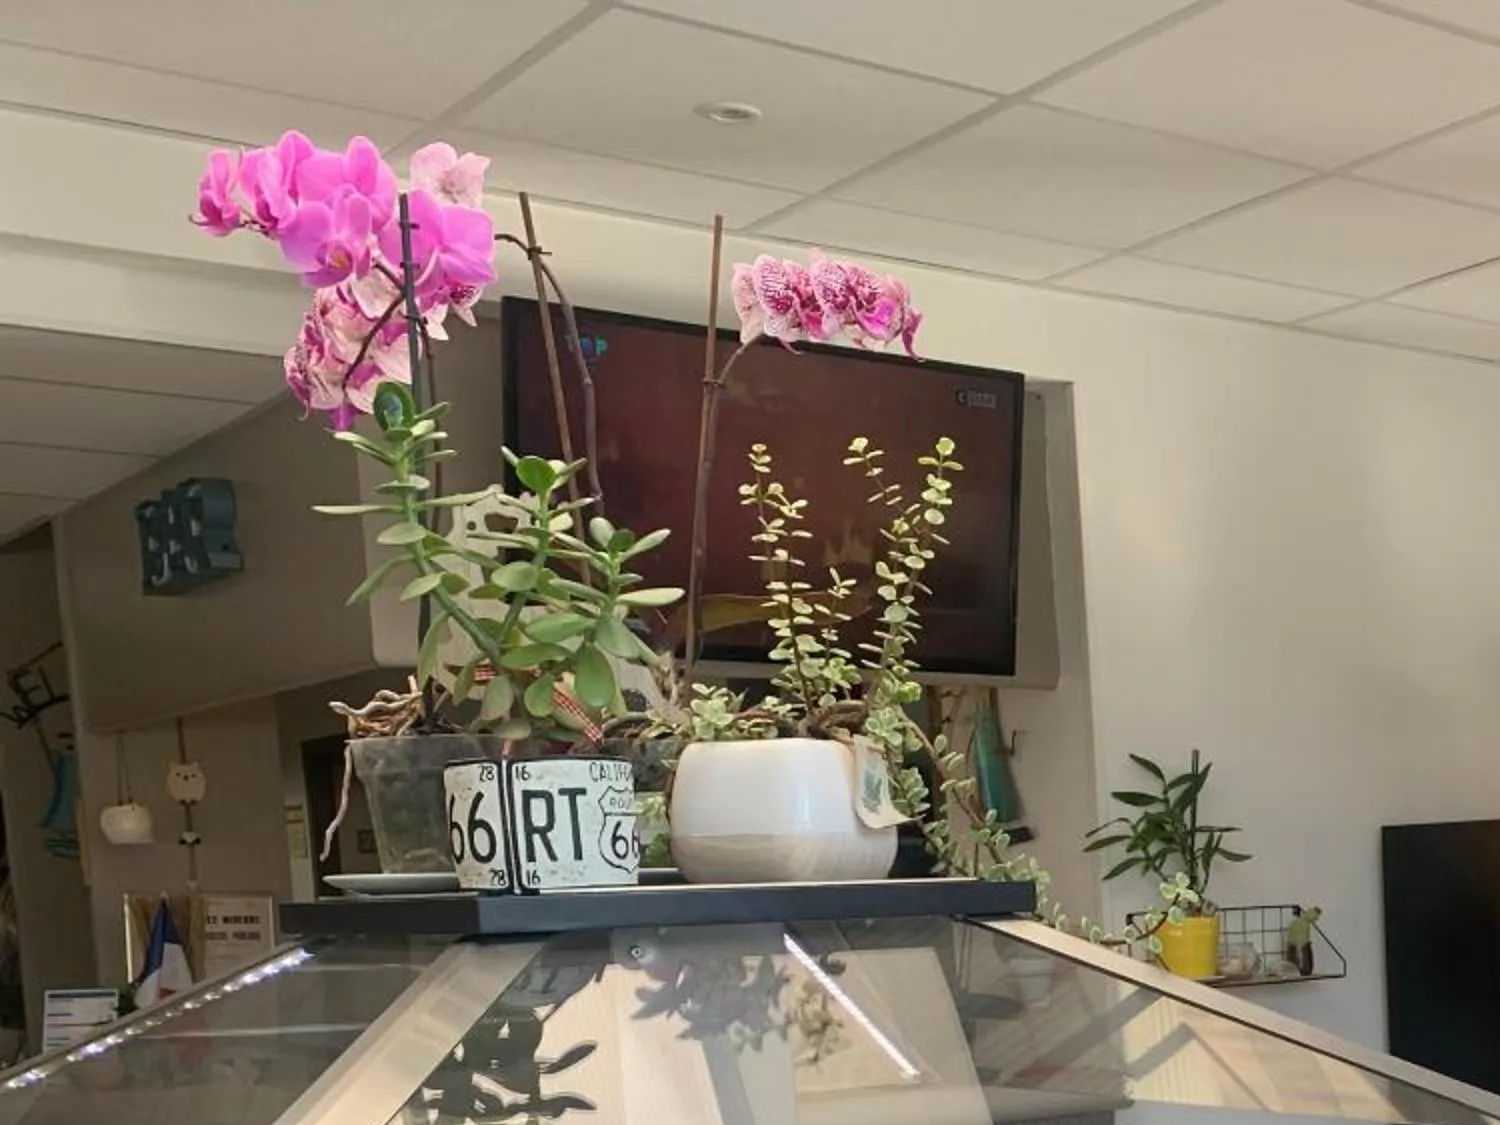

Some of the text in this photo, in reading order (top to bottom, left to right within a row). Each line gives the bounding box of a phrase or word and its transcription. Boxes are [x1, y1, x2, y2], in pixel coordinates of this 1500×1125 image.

[479, 765, 495, 782] 28
[515, 765, 531, 780] 16
[521, 787, 587, 862] RT
